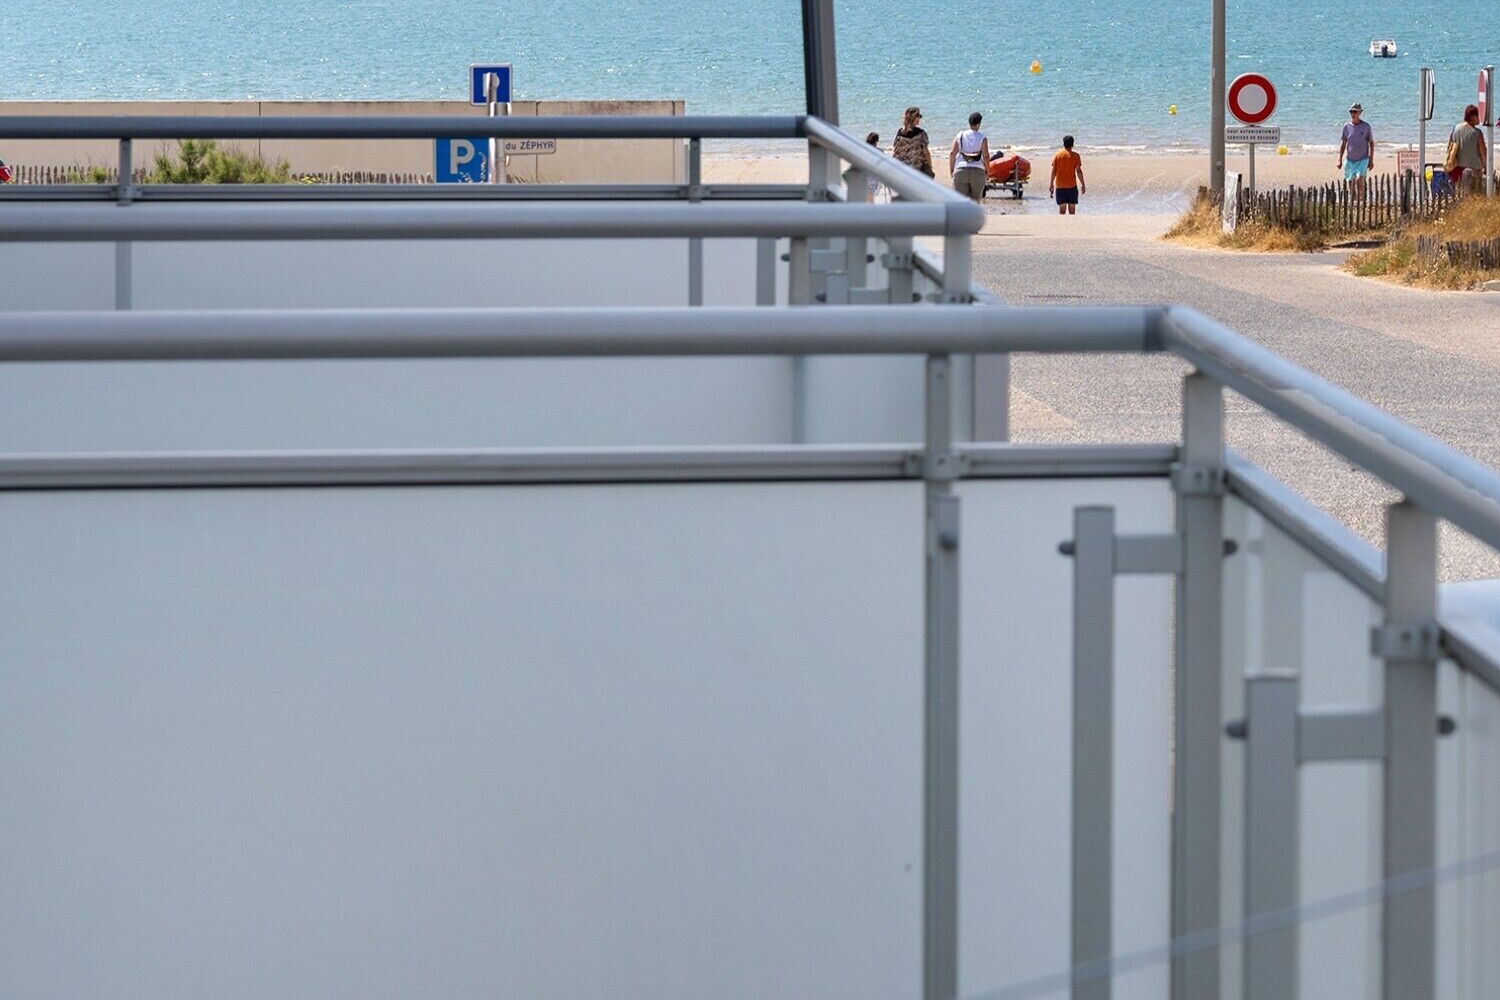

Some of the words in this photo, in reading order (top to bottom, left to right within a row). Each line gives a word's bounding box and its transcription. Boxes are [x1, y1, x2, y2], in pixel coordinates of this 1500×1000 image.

[505, 142, 516, 150] du
[520, 140, 554, 150] ZÉPHYR
[450, 139, 475, 174] P
